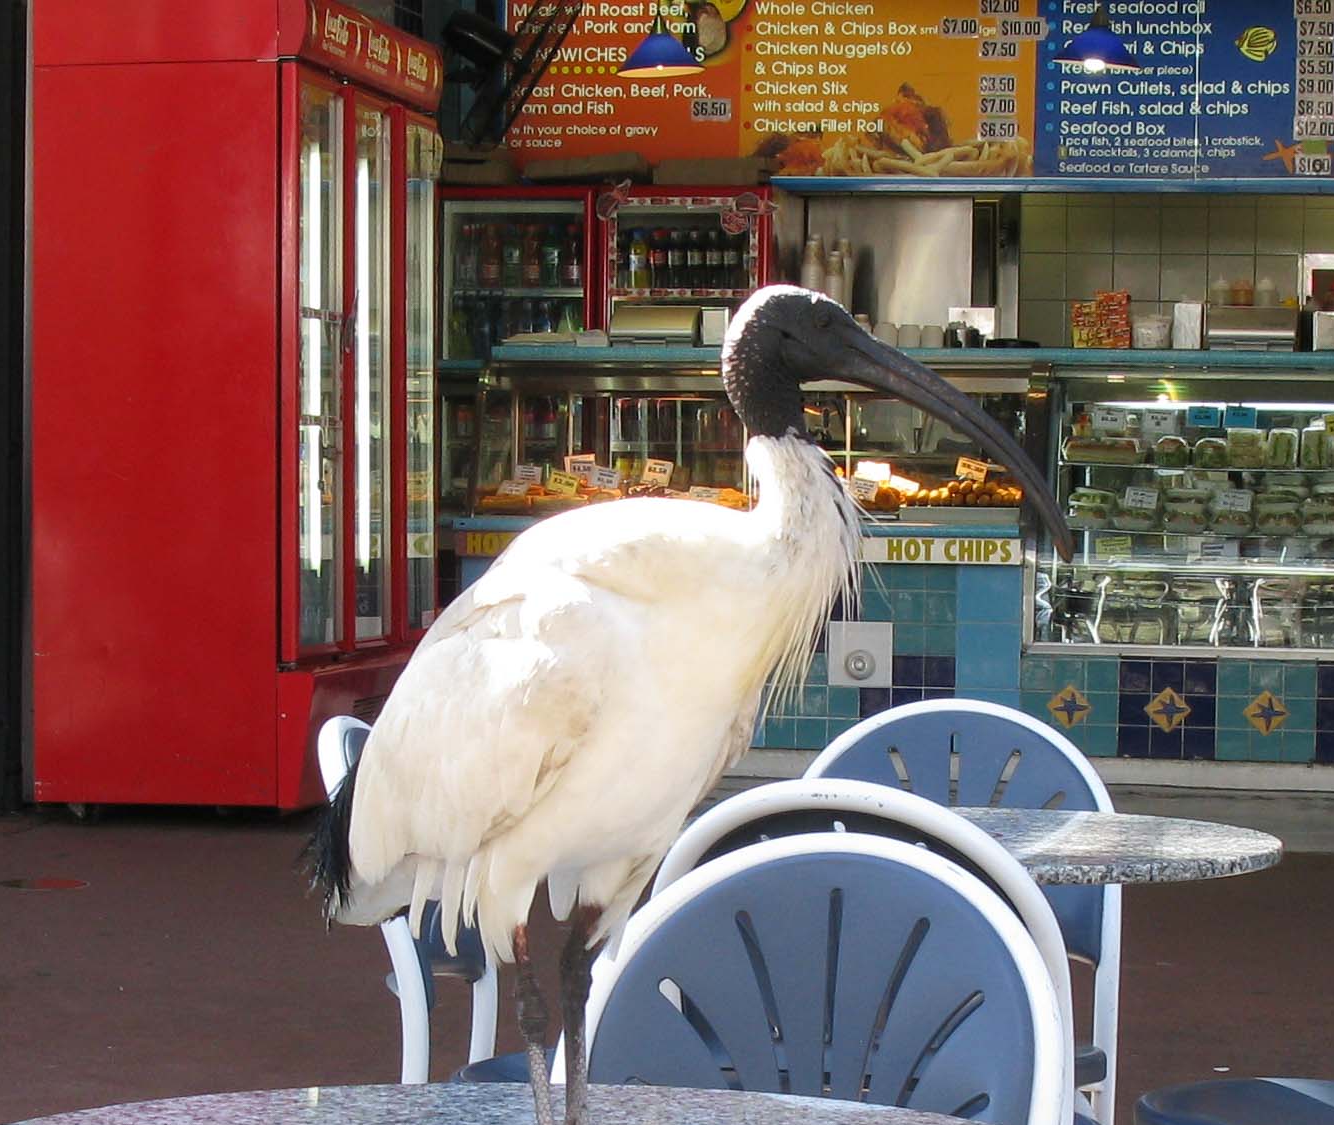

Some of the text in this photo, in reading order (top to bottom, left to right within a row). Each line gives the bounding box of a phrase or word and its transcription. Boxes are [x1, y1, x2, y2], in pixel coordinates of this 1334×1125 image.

[600, 2, 689, 18] Roast Beef,
[755, 2, 873, 15] Whole Chicken
[981, 0, 1019, 14] $12.00
[1109, 0, 1205, 14] seafood roll
[1296, 0, 1331, 14] $6.50
[585, 20, 618, 34] Pork
[756, 22, 917, 38] Chicken & Chips Box
[943, 19, 977, 34] $7.00
[1001, 20, 1041, 36] $10.00
[1136, 20, 1211, 34] lunchbox
[1299, 20, 1334, 36] $7.50
[755, 42, 818, 56] Chicken
[981, 42, 1017, 57] $7.50
[1143, 41, 1155, 54] &
[1161, 40, 1205, 58] Chips
[1299, 41, 1334, 56] $7.50
[754, 62, 847, 78] & Chips Box
[1157, 66, 1193, 76] piece)
[1299, 60, 1334, 75] $5.50
[561, 83, 711, 98] Chicken, Beef, Pork,
[755, 82, 848, 96] Chicken Stix
[980, 77, 1015, 92] $3.50
[1061, 81, 1290, 97] Prawn Cutlets, salad & chips
[1299, 79, 1333, 94] $9.00
[552, 101, 615, 114] and Fish
[693, 102, 727, 116] $6.50
[753, 100, 879, 114] with salad & chips
[980, 98, 1015, 114] $7.00
[1061, 101, 1249, 118] Reef Fish, salad chips
[1297, 100, 1333, 116] $8.50
[537, 124, 659, 138] your choice of gravy
[753, 119, 884, 132] Chicken Fillet Roll
[980, 122, 1015, 138] $6.50
[1060, 122, 1165, 136] Seafood Box
[526, 140, 563, 148] sauce
[1123, 136, 1171, 146] seafood
[1069, 148, 1086, 156] fish
[1207, 148, 1235, 158] chips
[1059, 162, 1209, 174] Seafood or Tartare Sauce
[887, 538, 1012, 562] HOT CHIPS
